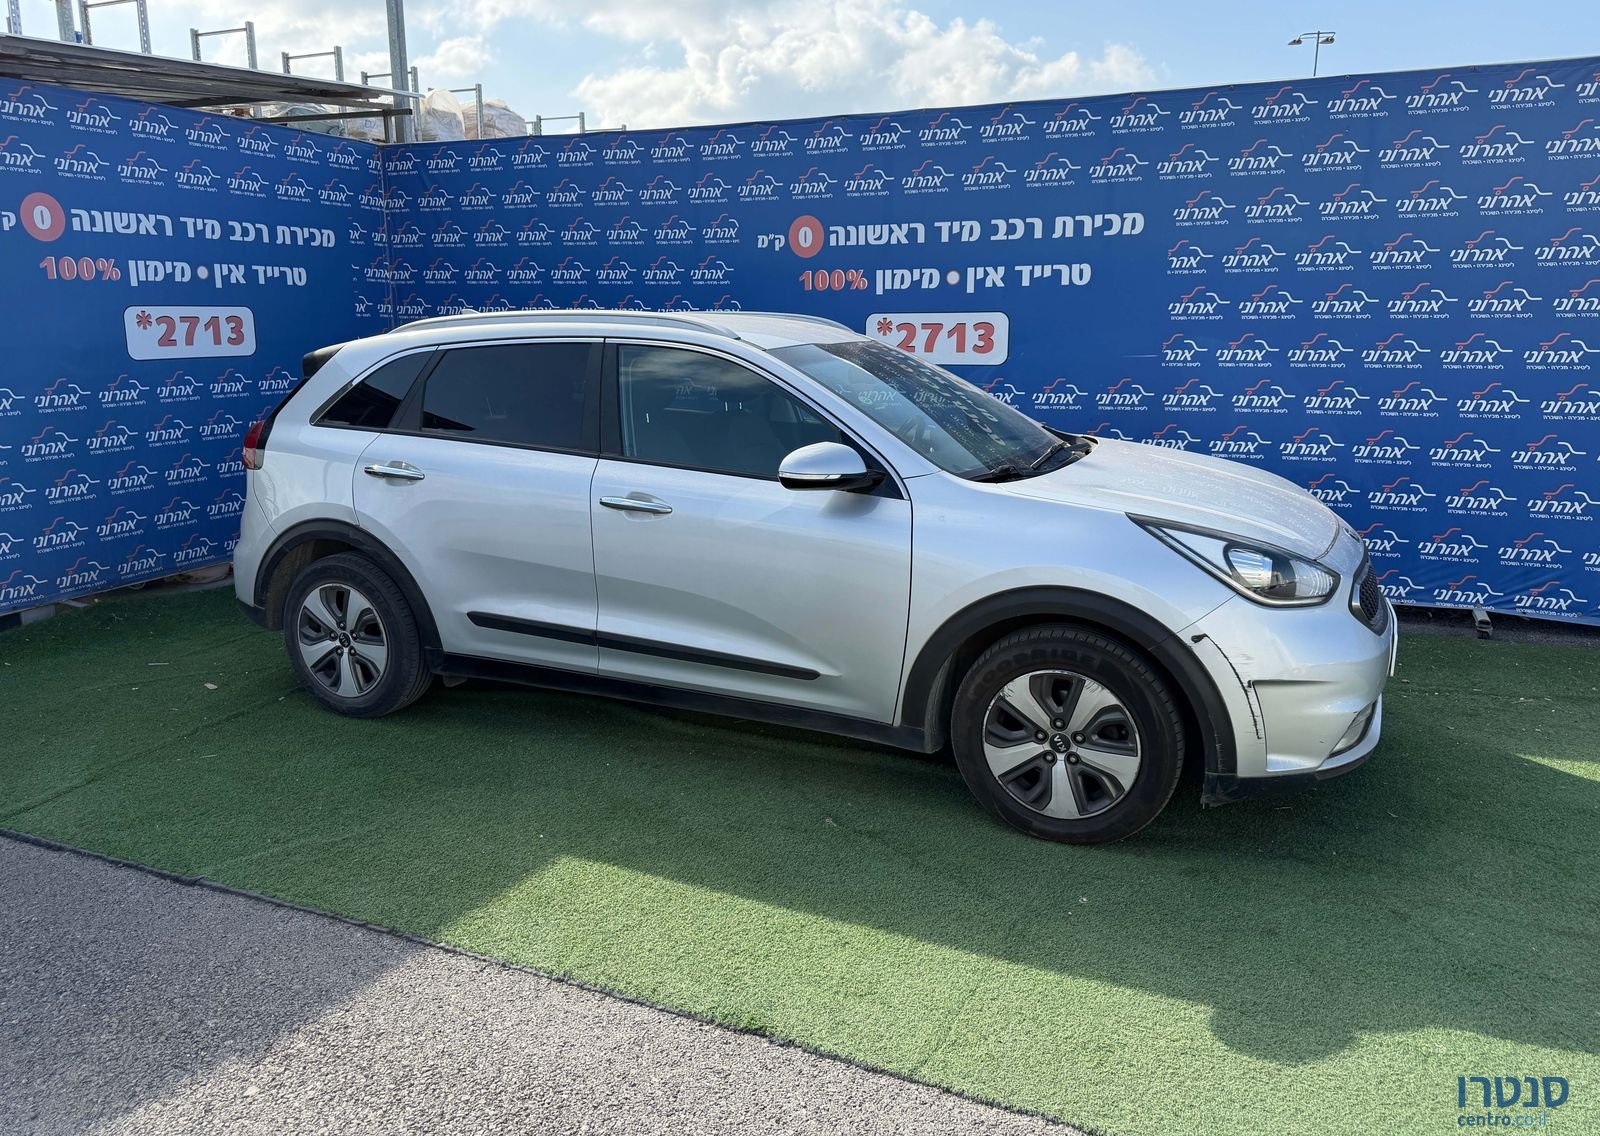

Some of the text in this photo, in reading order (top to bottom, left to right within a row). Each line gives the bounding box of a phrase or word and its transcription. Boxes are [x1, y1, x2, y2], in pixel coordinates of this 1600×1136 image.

[1405, 91, 1463, 108] אהרוני
[1488, 86, 1549, 102] אהרוני
[1251, 103, 1304, 118] אהרוני
[1327, 97, 1382, 113] אהרוני
[66, 111, 110, 127] אהרוני
[1110, 113, 1158, 128] אהרוני
[1179, 108, 1229, 123] אהרוני
[980, 123, 1024, 137] אהרוני
[1043, 118, 1090, 133] אהרוני
[918, 128, 961, 141] אהרוני
[751, 140, 788, 152] אהרוני
[1459, 143, 1519, 158] אהרוני
[1301, 151, 1356, 166] אהרוני
[1378, 147, 1435, 162] אהרוני
[54, 158, 99, 174] אהרוני
[1156, 160, 1206, 174] אהרוני
[1227, 156, 1280, 170] אהרוני
[117, 165, 158, 179] אהרוני
[1024, 168, 1069, 181] אהרוני
[1089, 163, 1136, 178] אהרוני
[844, 179, 884, 191] אהרוני
[902, 175, 943, 188] אהרוני
[961, 171, 1005, 185] אהרוני
[737, 184, 774, 196] אהרוני
[789, 181, 828, 194] אהרוני
[1318, 200, 1373, 214] אהרוני
[1395, 197, 1453, 212] אהרוני
[1477, 194, 1537, 209] אהרוני
[1173, 207, 1223, 220] אהרוני
[1244, 204, 1296, 217] אהרוני
[70, 208, 173, 236] ראשונה
[179, 216, 221, 240] מיד
[990, 217, 1043, 241] רכב
[1052, 212, 1145, 239] מכירת
[228, 220, 270, 243] רכב
[276, 225, 336, 248] מכירת
[798, 226, 813, 248] 0
[829, 223, 925, 247] ראשונה
[934, 220, 981, 242] מיד
[1222, 254, 1273, 267] אהרוני
[1294, 252, 1348, 265] אהרוני
[1370, 250, 1426, 263] אהרוני
[1450, 248, 1508, 262] אהרוני
[39, 256, 307, 289] טרייד אין מימון 100%
[799, 263, 1092, 295] טרייד אין מימון 100%
[1168, 302, 1218, 314] אהרוני
[1238, 301, 1290, 313] אהרוני
[1311, 300, 1365, 313] אהרוני
[1387, 300, 1443, 312] אהרוני
[1468, 299, 1527, 312] אהרוני
[1216, 349, 1266, 361] אהרוני
[1287, 349, 1340, 361] אהרוני
[1361, 350, 1417, 362] אהרוני
[1440, 350, 1498, 363] אהרוני
[1523, 350, 1584, 363] אהרוני
[157, 385, 194, 397] אהרוני
[34, 393, 80, 407] אהרוני
[1032, 393, 1077, 404] אהרוני
[1095, 393, 1142, 405] אהרוני
[1162, 394, 1211, 406] אהרוני
[1231, 395, 1282, 407] אהרוני
[1303, 396, 1356, 409] אהרוני
[1377, 398, 1433, 411] אהרוני
[1456, 399, 1515, 412] אהרוני
[21, 441, 67, 456] אהרוני
[86, 434, 128, 449] אהרוני
[1209, 440, 1259, 453] אהרוני
[1279, 443, 1331, 456] אהרוני
[1352, 445, 1406, 459] אהרוני
[1429, 448, 1486, 461] אהרוני
[1511, 451, 1571, 464] אהרוני
[165, 466, 201, 481] אהרוני
[45, 482, 89, 499] אהרוני
[1368, 492, 1422, 505] אהרוני
[1445, 495, 1502, 510] אהרוני
[1527, 499, 1587, 514] אהרוני
[96, 519, 137, 536] אהרוני
[33, 530, 77, 548] אהרוני
[1417, 542, 1474, 556] אהרוני
[1498, 547, 1557, 562] אהרוני
[118, 556, 157, 574] אהרוני
[56, 569, 99, 588] אהרוני
[1433, 589, 1489, 604] אהרוני
[1513, 595, 1572, 610] אהרוני
